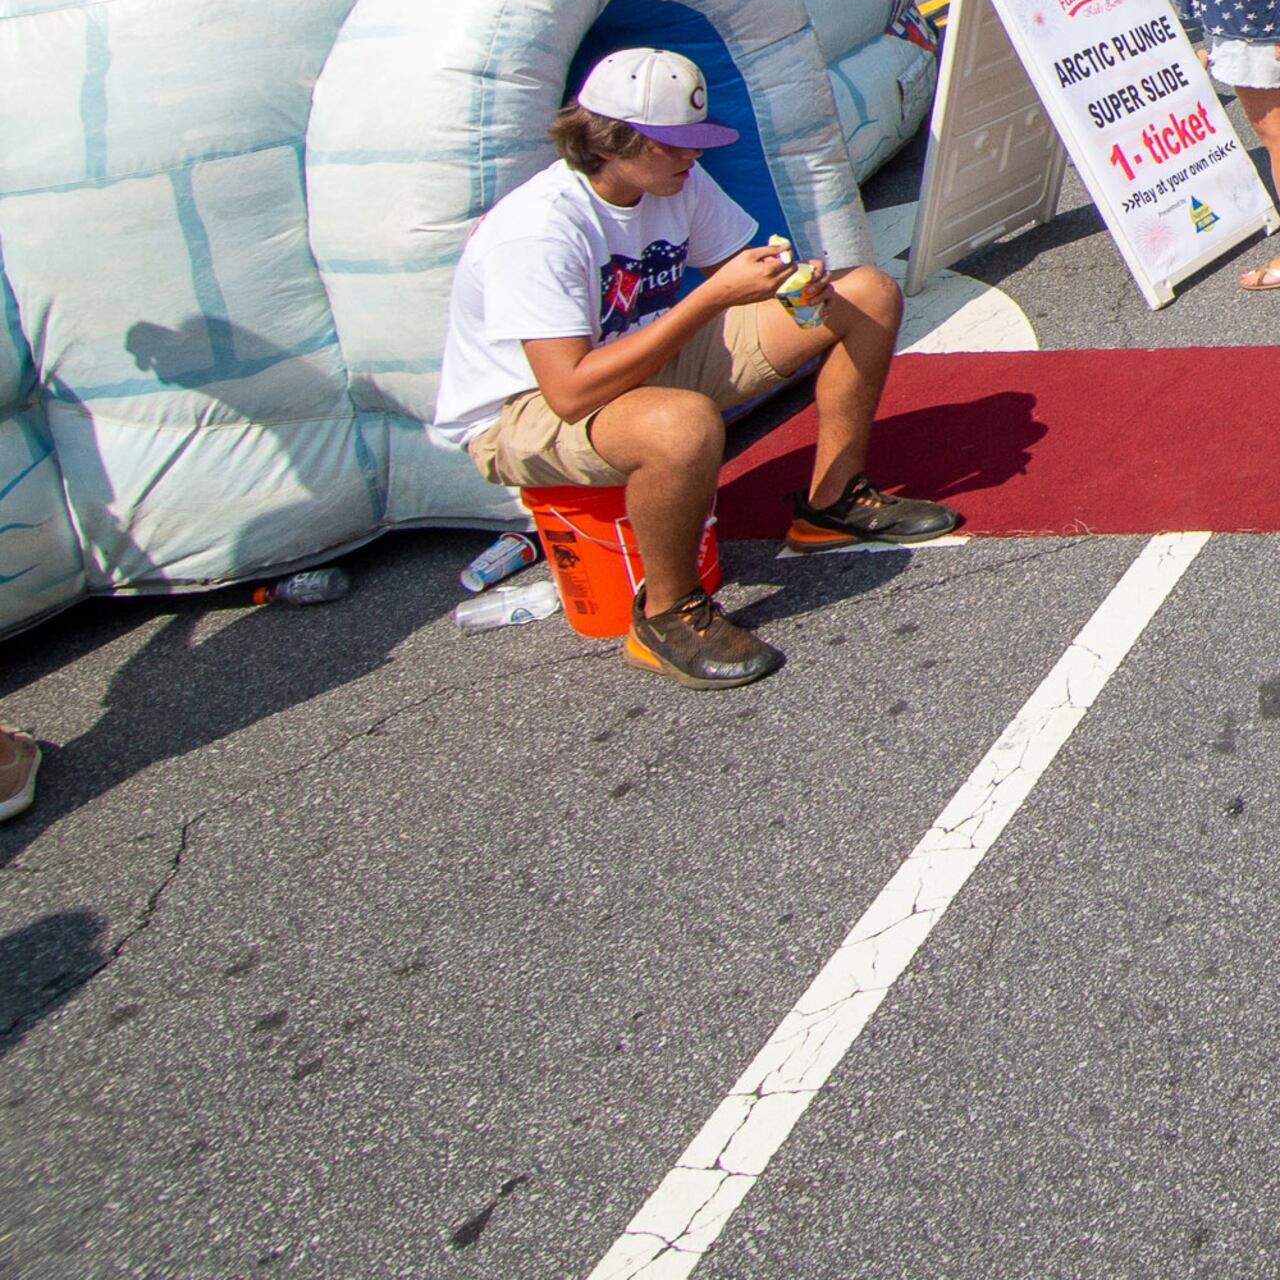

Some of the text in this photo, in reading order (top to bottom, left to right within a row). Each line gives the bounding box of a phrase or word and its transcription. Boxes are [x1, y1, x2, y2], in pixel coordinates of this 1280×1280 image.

[1054, 16, 1177, 88] ARCTIC PLUNGE
[1088, 63, 1190, 129] SUPER SLIDE
[1141, 100, 1217, 165] ticket
[1156, 178, 1169, 196] at
[1166, 165, 1190, 193] your
[1189, 157, 1210, 176] own
